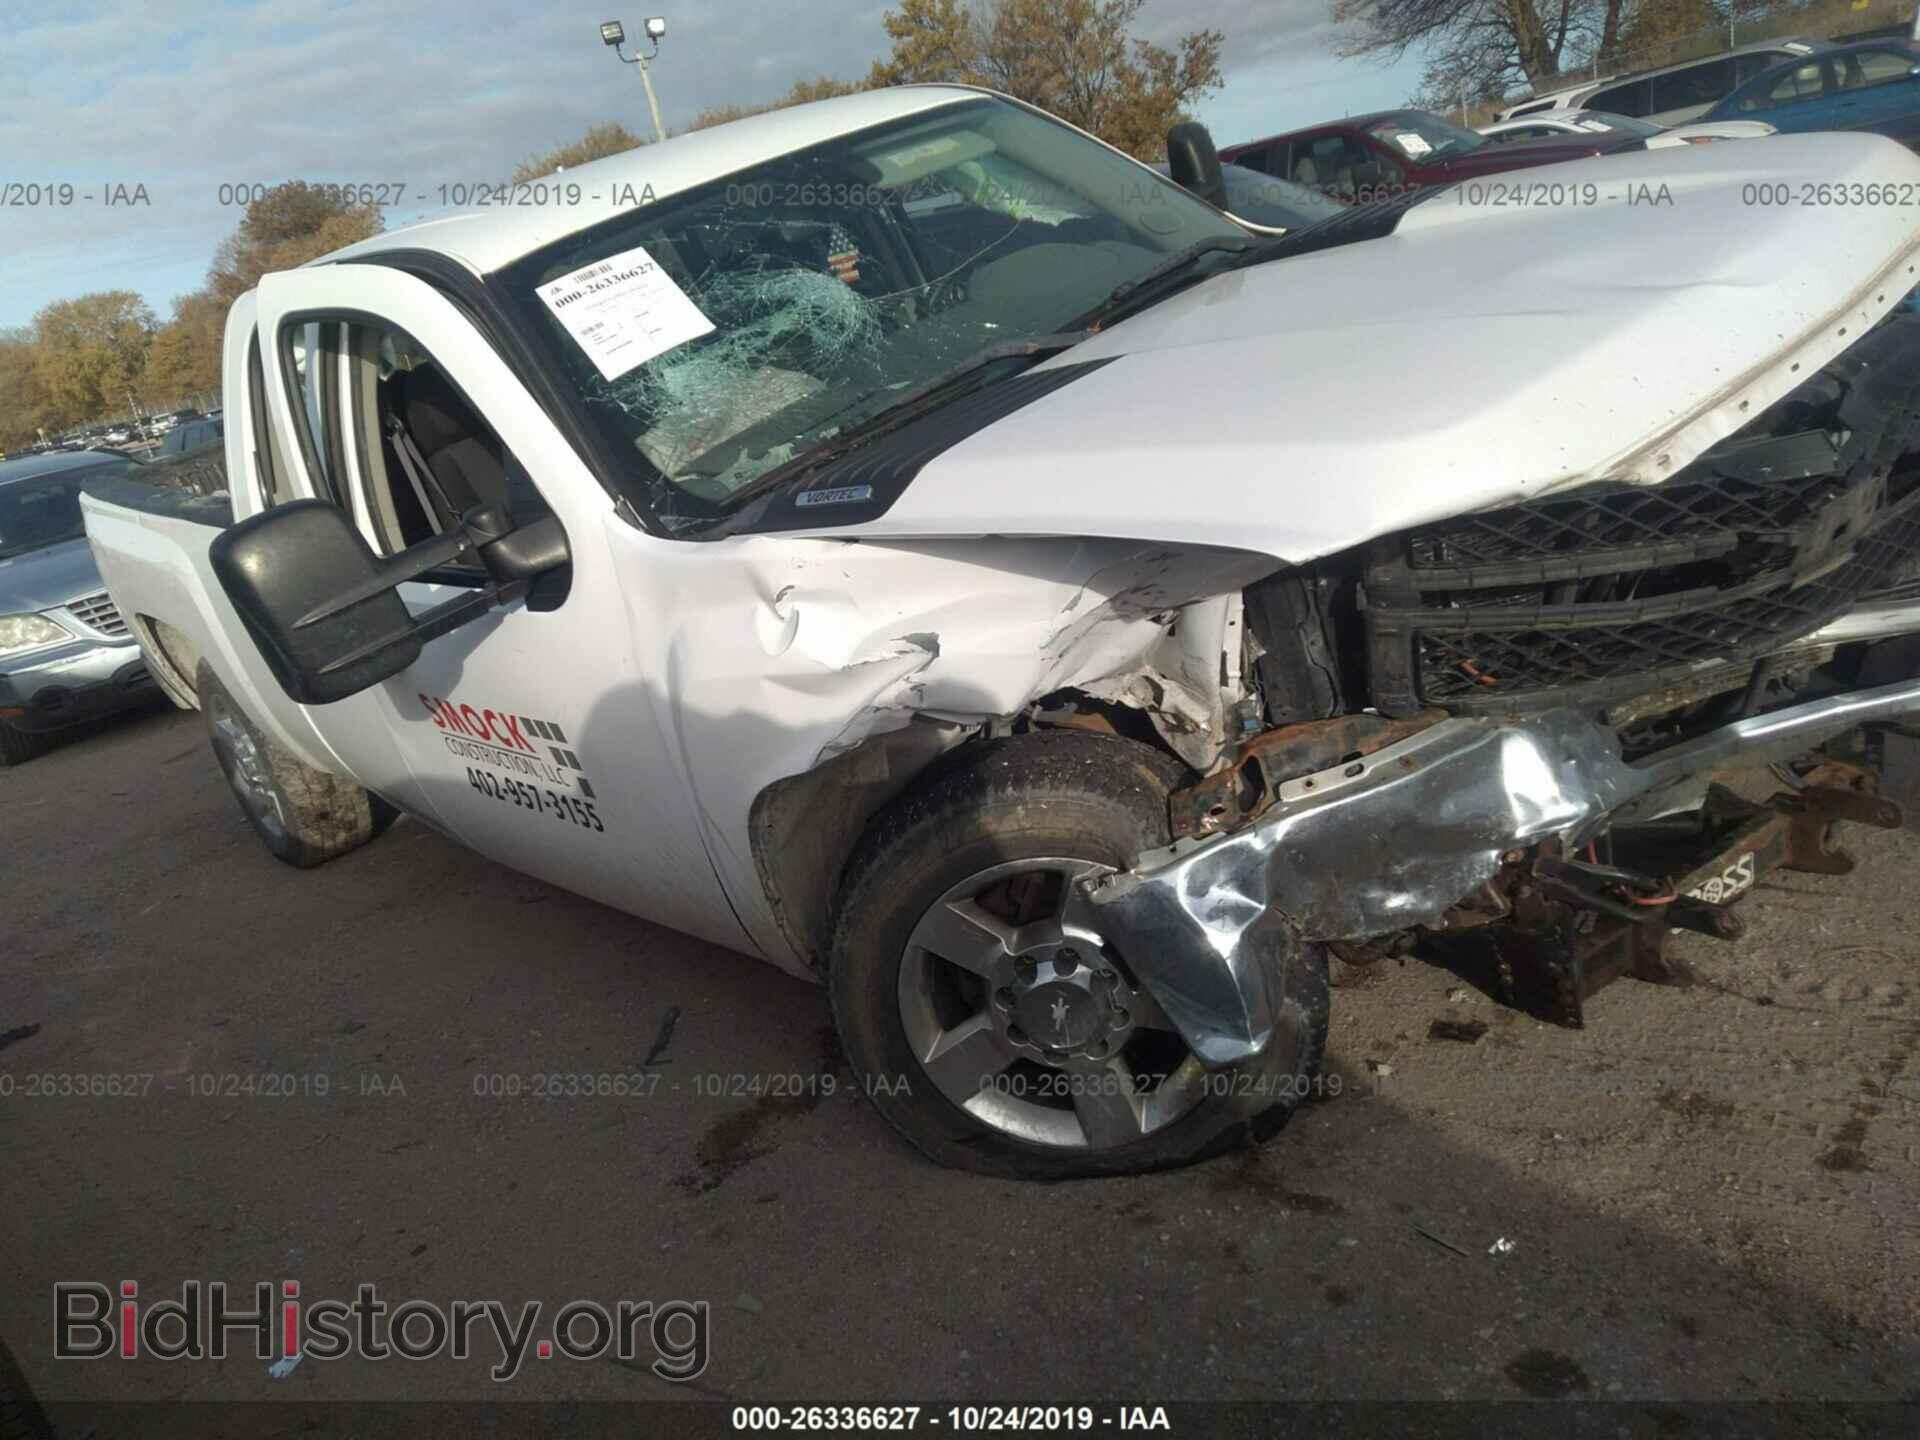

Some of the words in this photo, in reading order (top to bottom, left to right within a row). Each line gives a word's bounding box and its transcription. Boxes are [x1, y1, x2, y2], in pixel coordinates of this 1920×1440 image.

[554, 262, 655, 309] 000-26336627
[418, 693, 536, 753] SMOCK
[445, 737, 544, 781] CONSTRUCTION,
[543, 762, 571, 788] LLC
[466, 766, 604, 832] 402-957-3155
